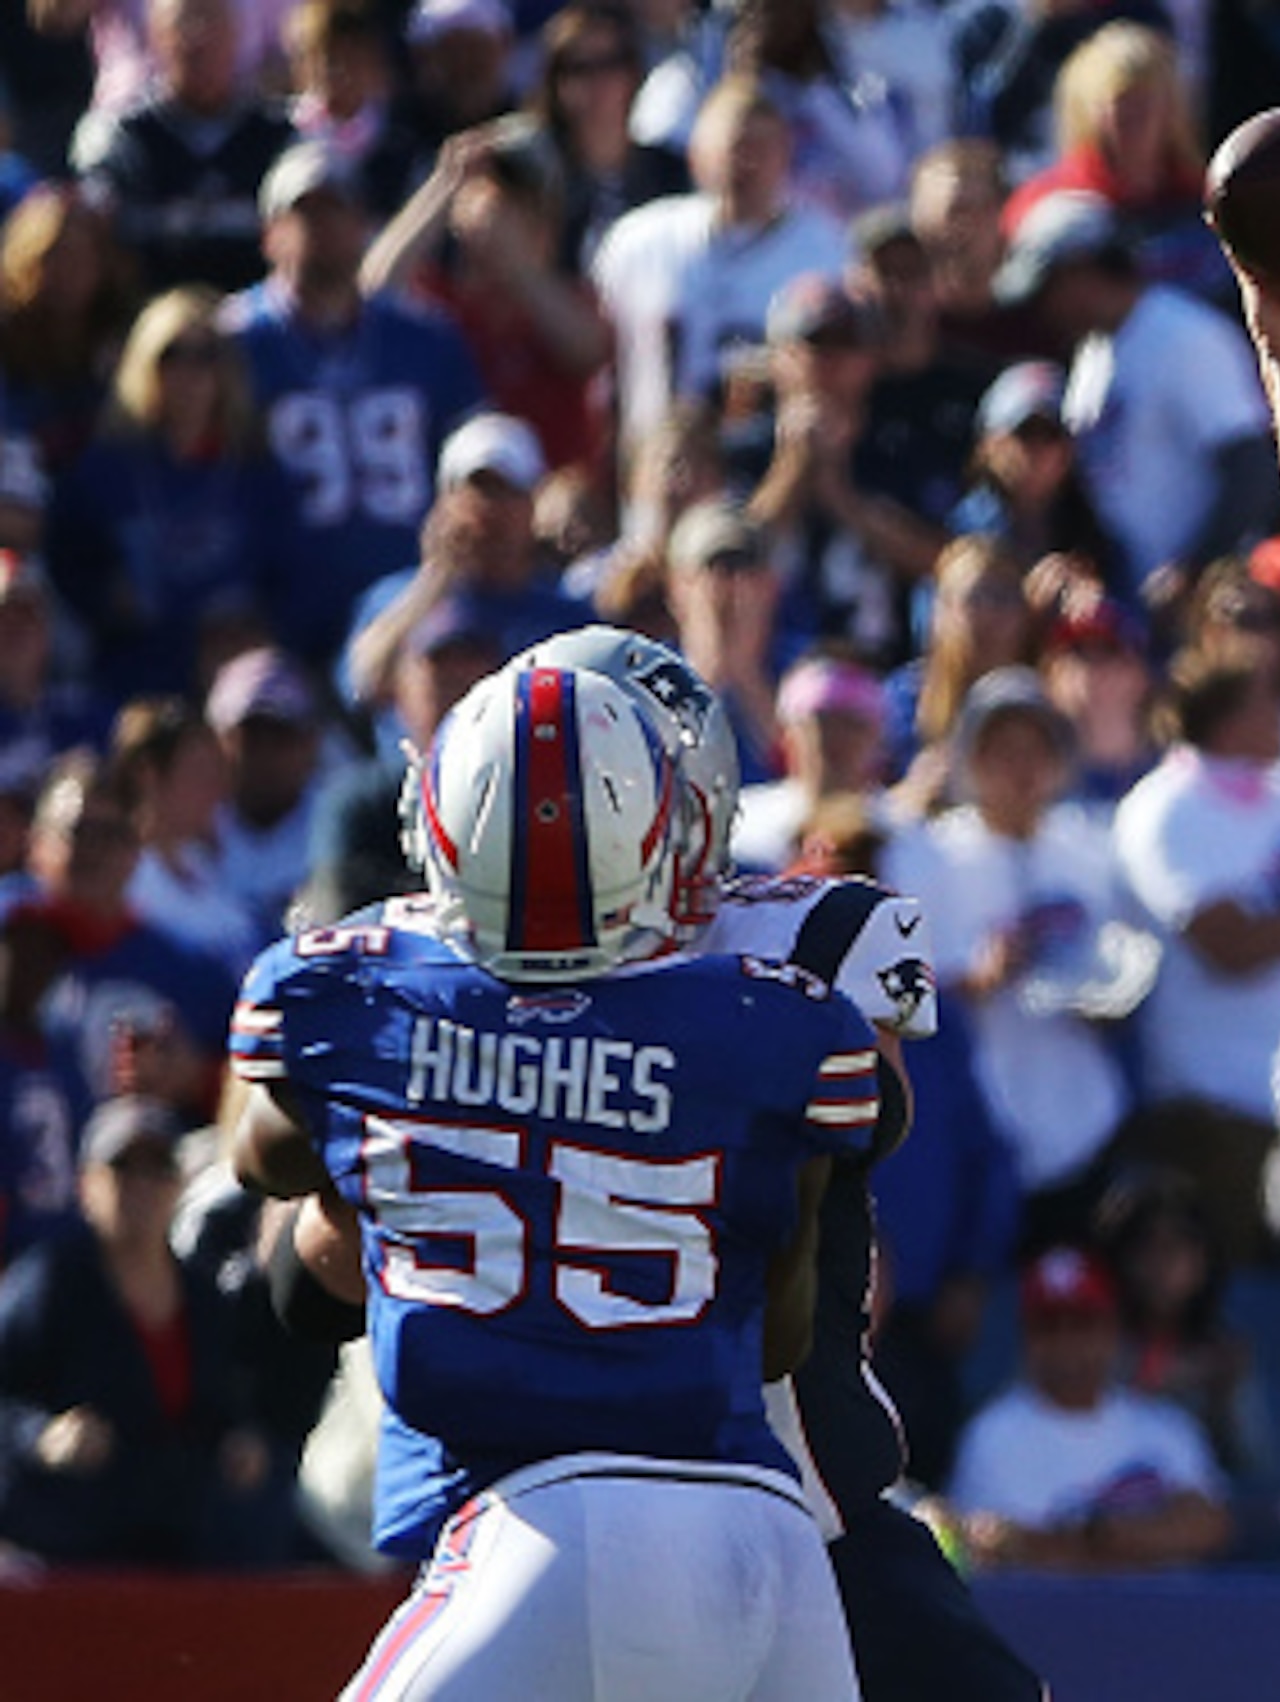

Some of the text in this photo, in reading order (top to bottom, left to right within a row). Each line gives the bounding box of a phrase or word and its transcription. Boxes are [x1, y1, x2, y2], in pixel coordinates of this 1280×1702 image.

[268, 390, 427, 524] 99
[407, 1018, 675, 1133] HUGHES
[360, 1110, 724, 1332] 55
